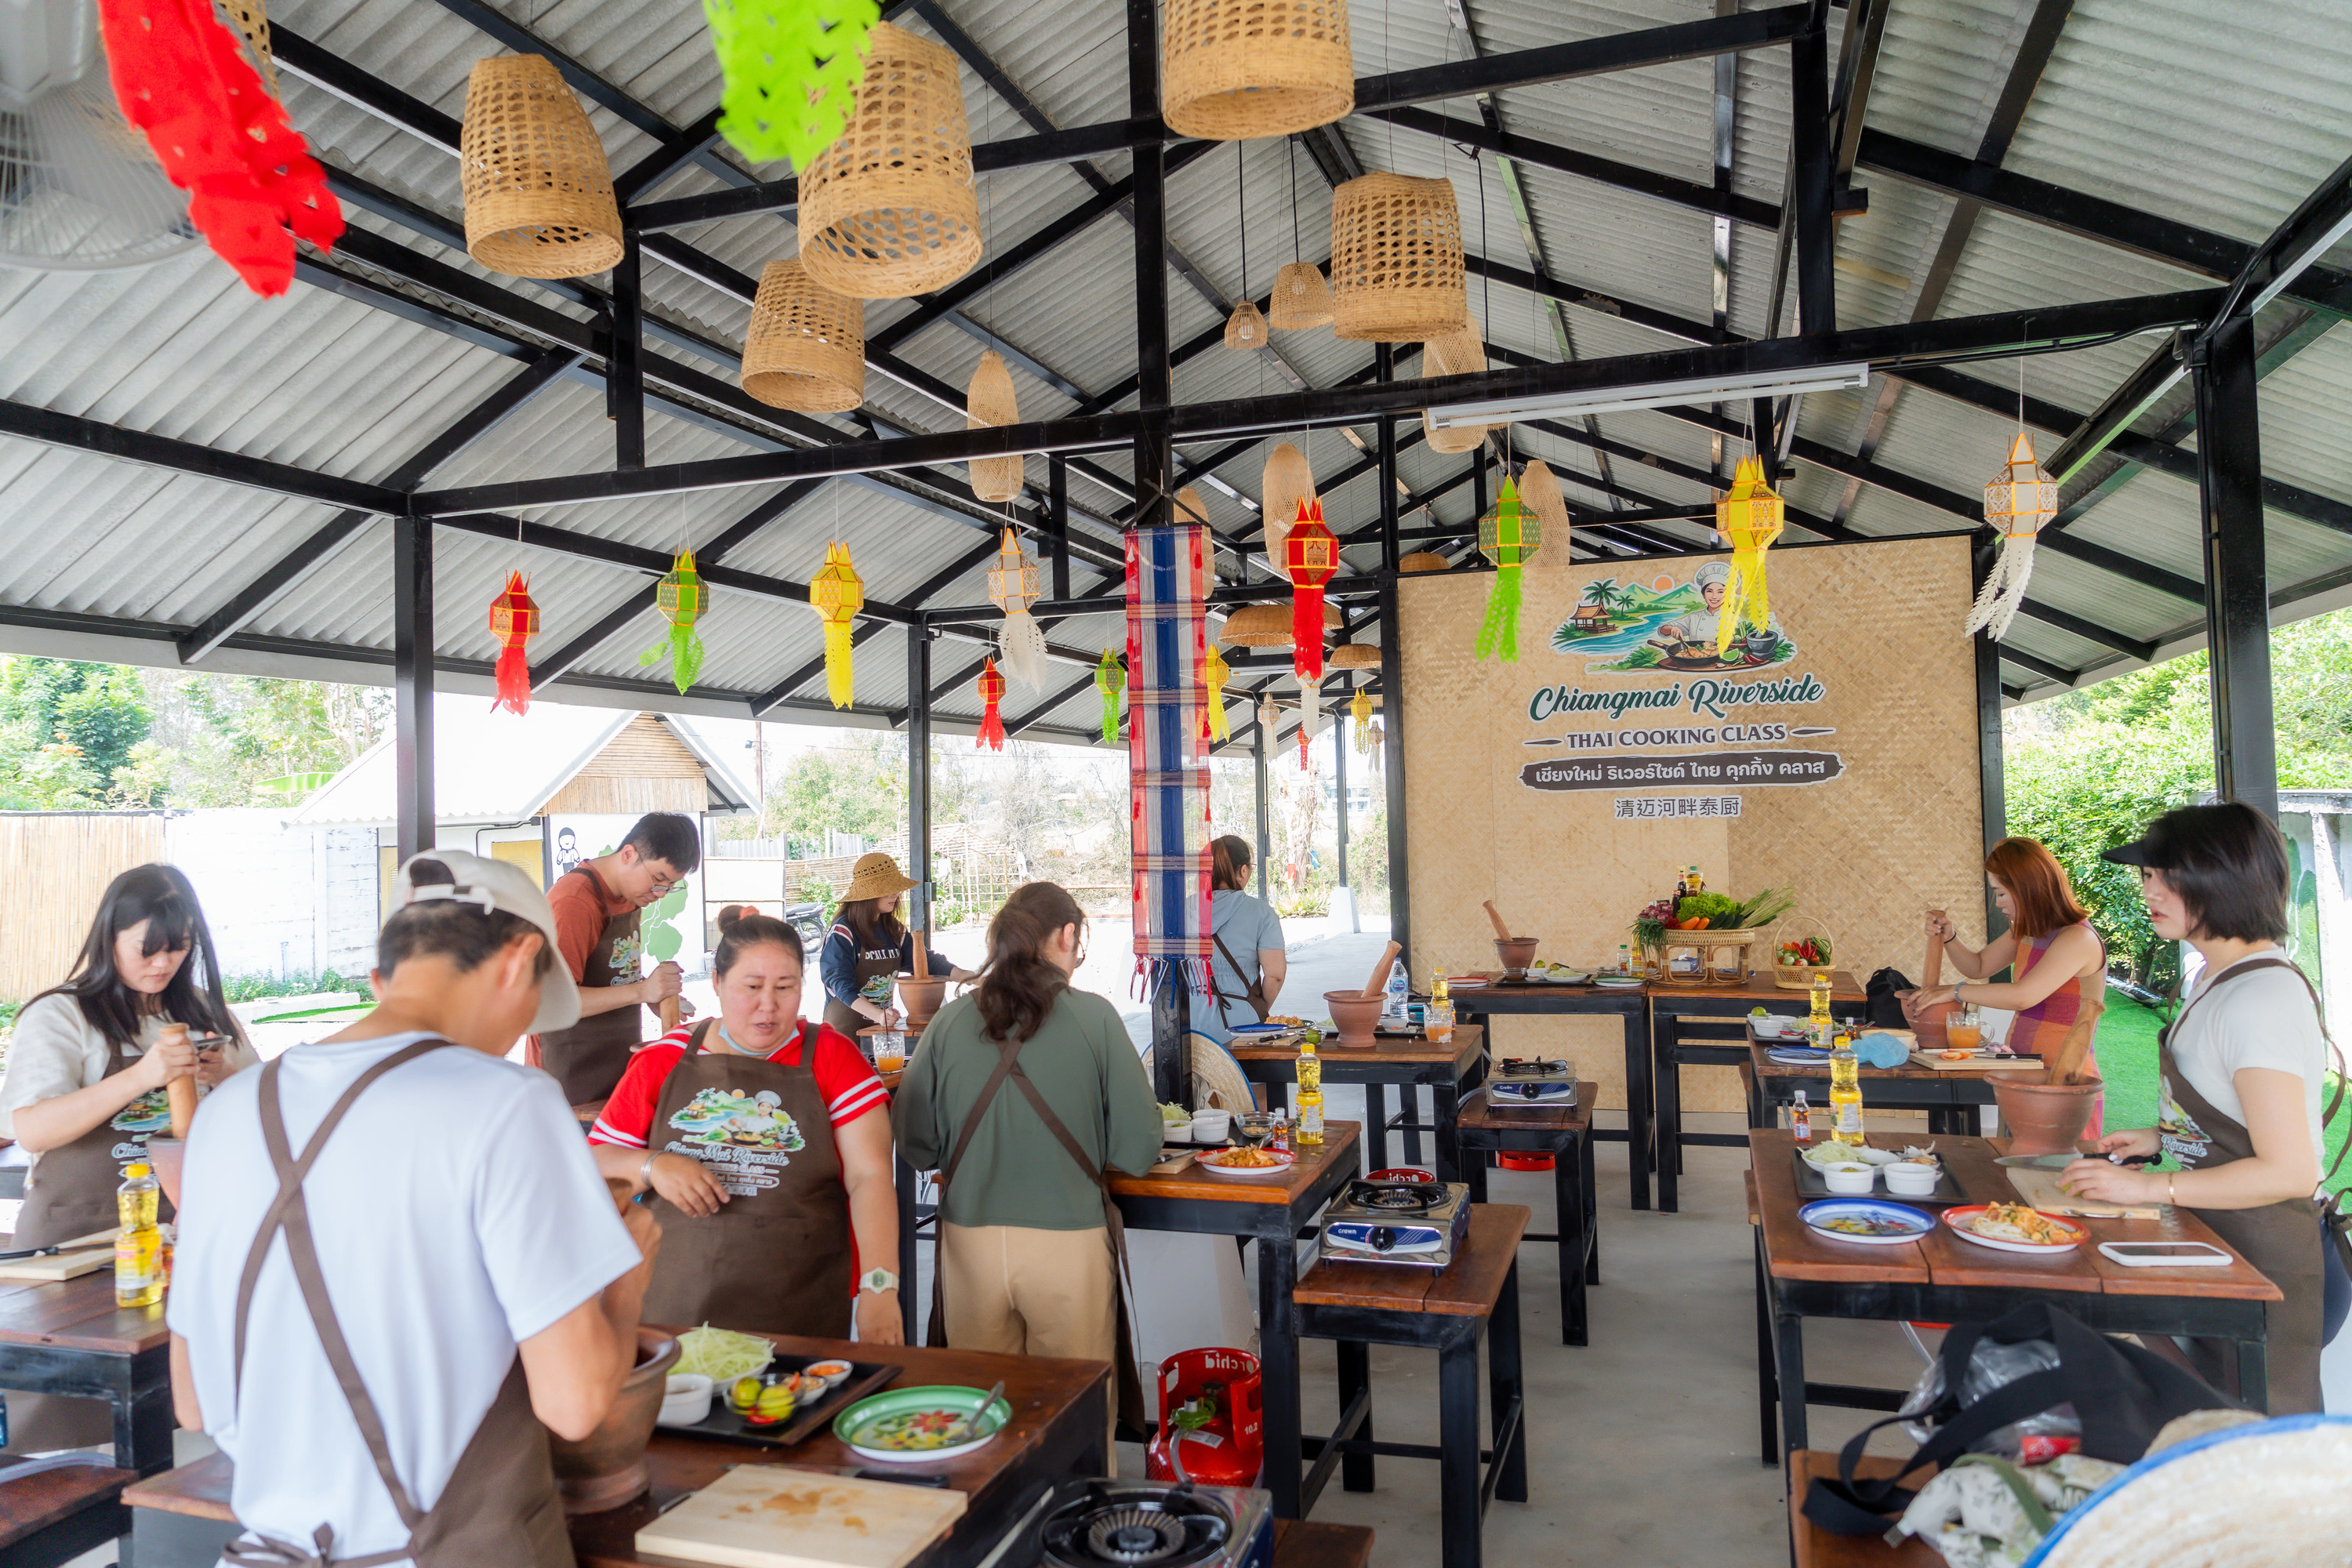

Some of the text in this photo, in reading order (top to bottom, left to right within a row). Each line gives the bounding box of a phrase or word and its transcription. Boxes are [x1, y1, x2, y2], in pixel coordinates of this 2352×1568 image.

[1530, 674, 1824, 720] Chiangmai Riverside
[1567, 725, 1786, 748] THAI COOKING CLASS
[1536, 757, 1824, 782] เชียงใหม่ ริเวอร์ไซด์ ไทย คุกกิ้ง คลาส
[1617, 797, 1739, 818] 清迈河畔泰厨
[111, 1142, 150, 1159] Chian
[732, 1146, 789, 1166] Riverside
[2161, 1134, 2208, 1157] Riverside
[1244, 1422, 1258, 1435] 10.2
